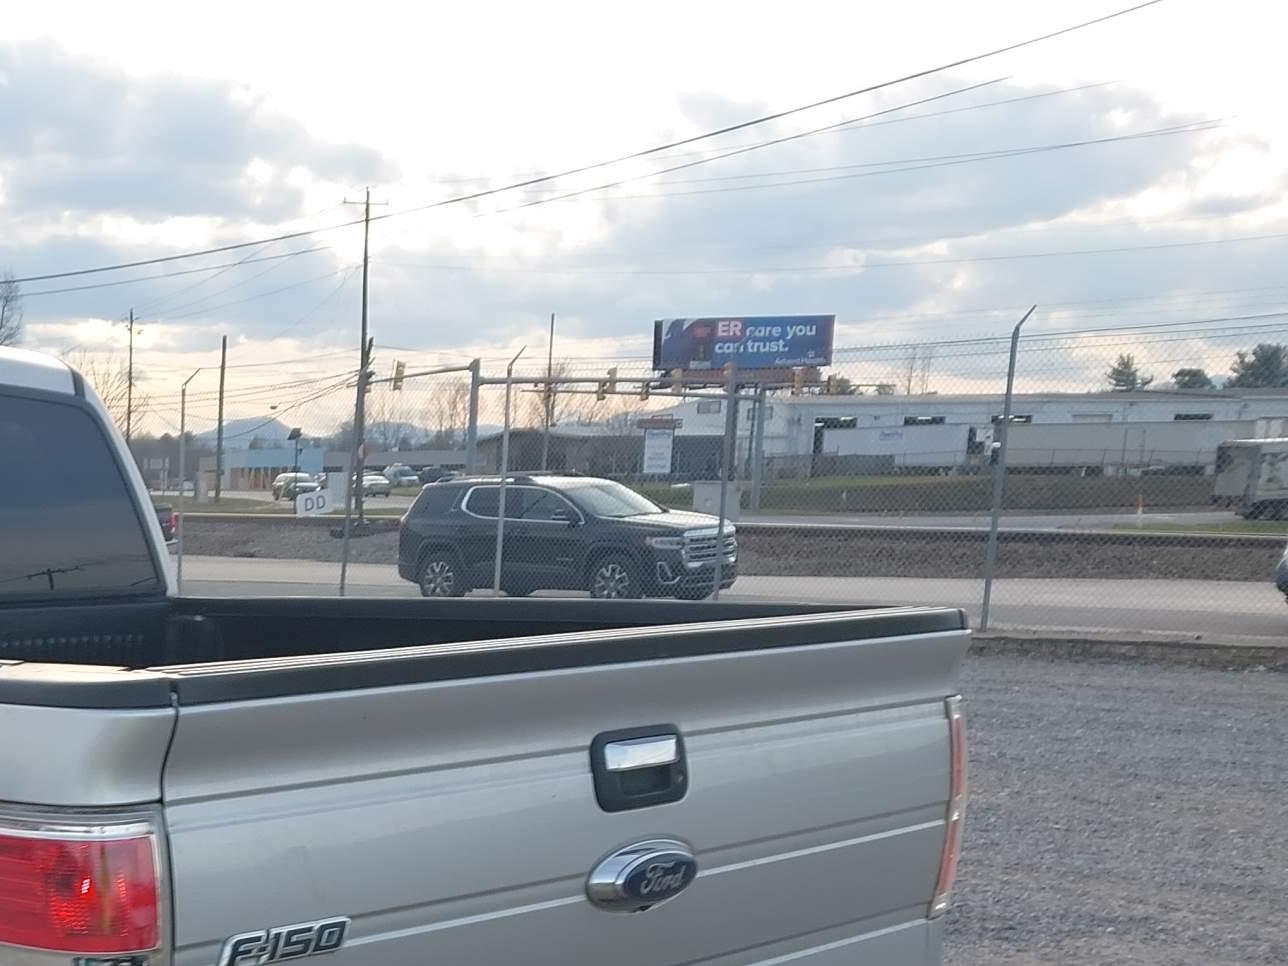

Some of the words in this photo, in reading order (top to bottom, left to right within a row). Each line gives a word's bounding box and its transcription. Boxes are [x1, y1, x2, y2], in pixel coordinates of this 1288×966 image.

[717, 320, 743, 337] ER
[746, 325, 782, 337] care
[786, 324, 817, 339] you
[746, 339, 789, 353] trust.
[639, 860, 687, 895] Ford
